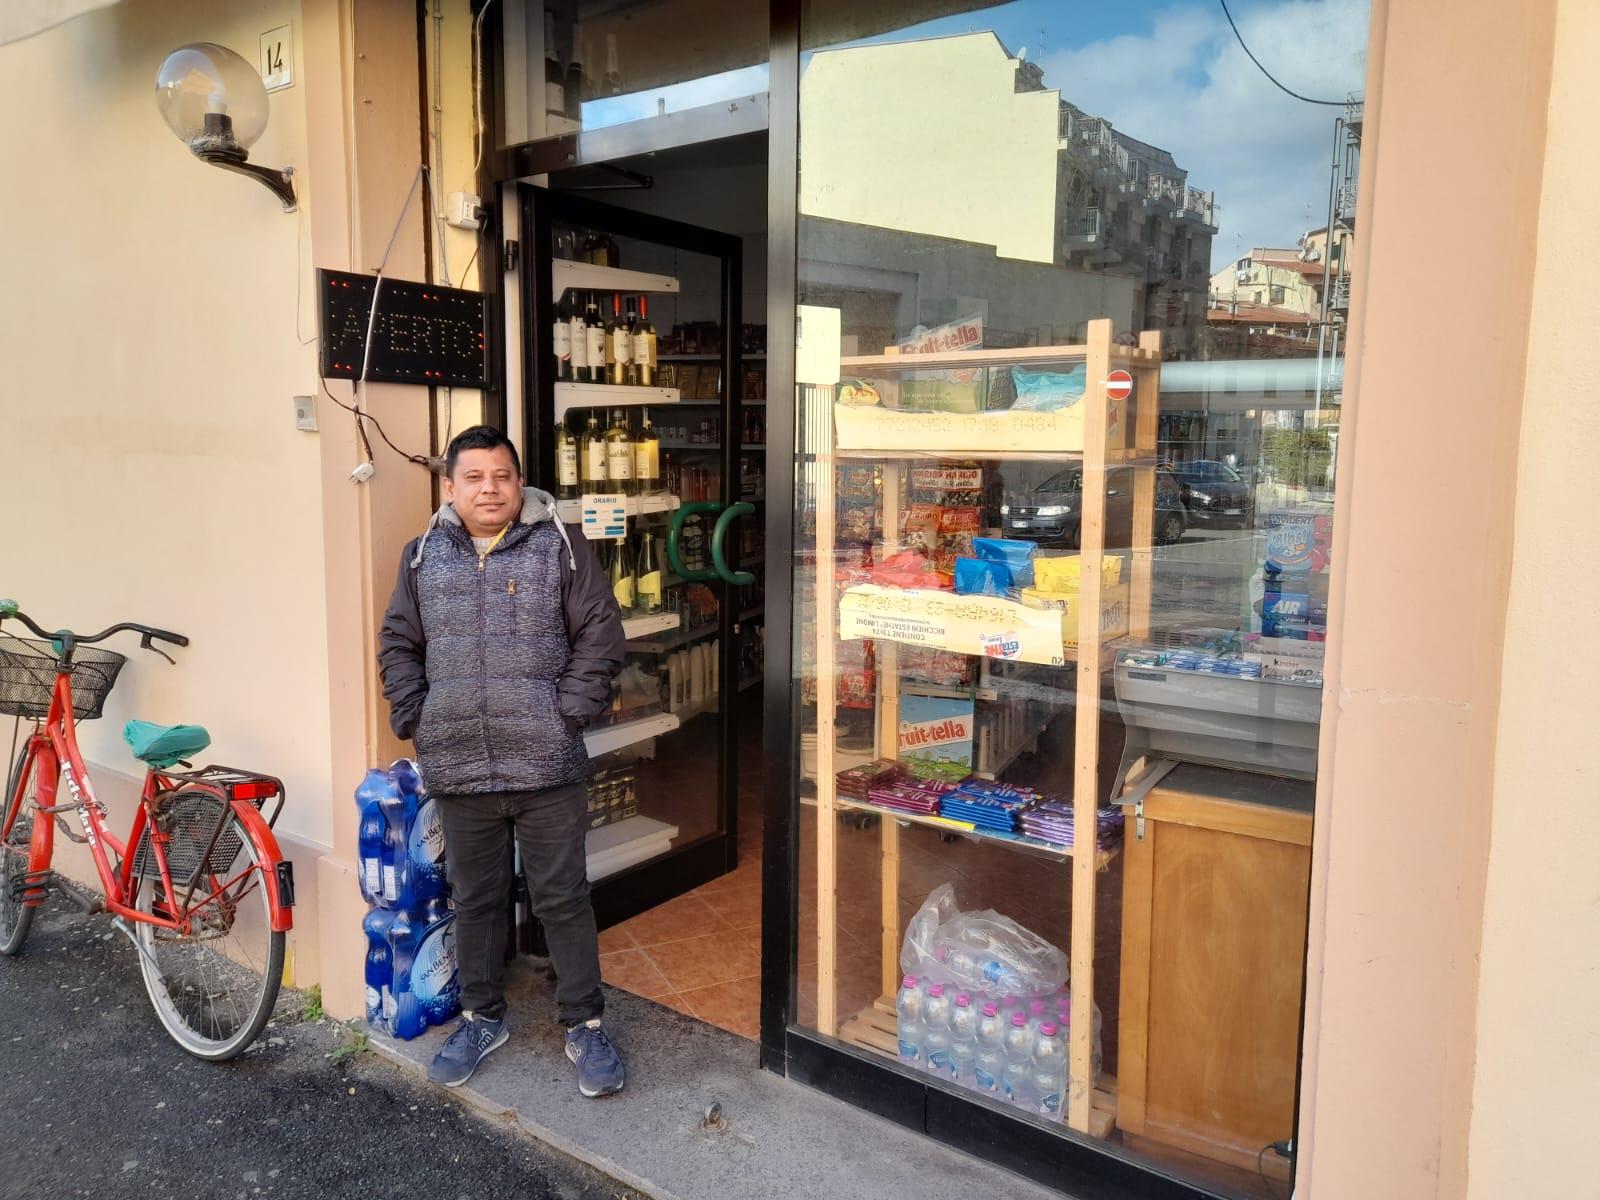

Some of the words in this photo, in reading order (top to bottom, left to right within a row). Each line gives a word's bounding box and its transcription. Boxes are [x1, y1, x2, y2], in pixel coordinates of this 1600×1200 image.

[267, 42, 283, 75] 14
[339, 307, 475, 358] APERTO
[1270, 600, 1301, 615] AIR
[855, 616, 880, 627] LIMONE
[898, 720, 967, 747] ruit-tella
